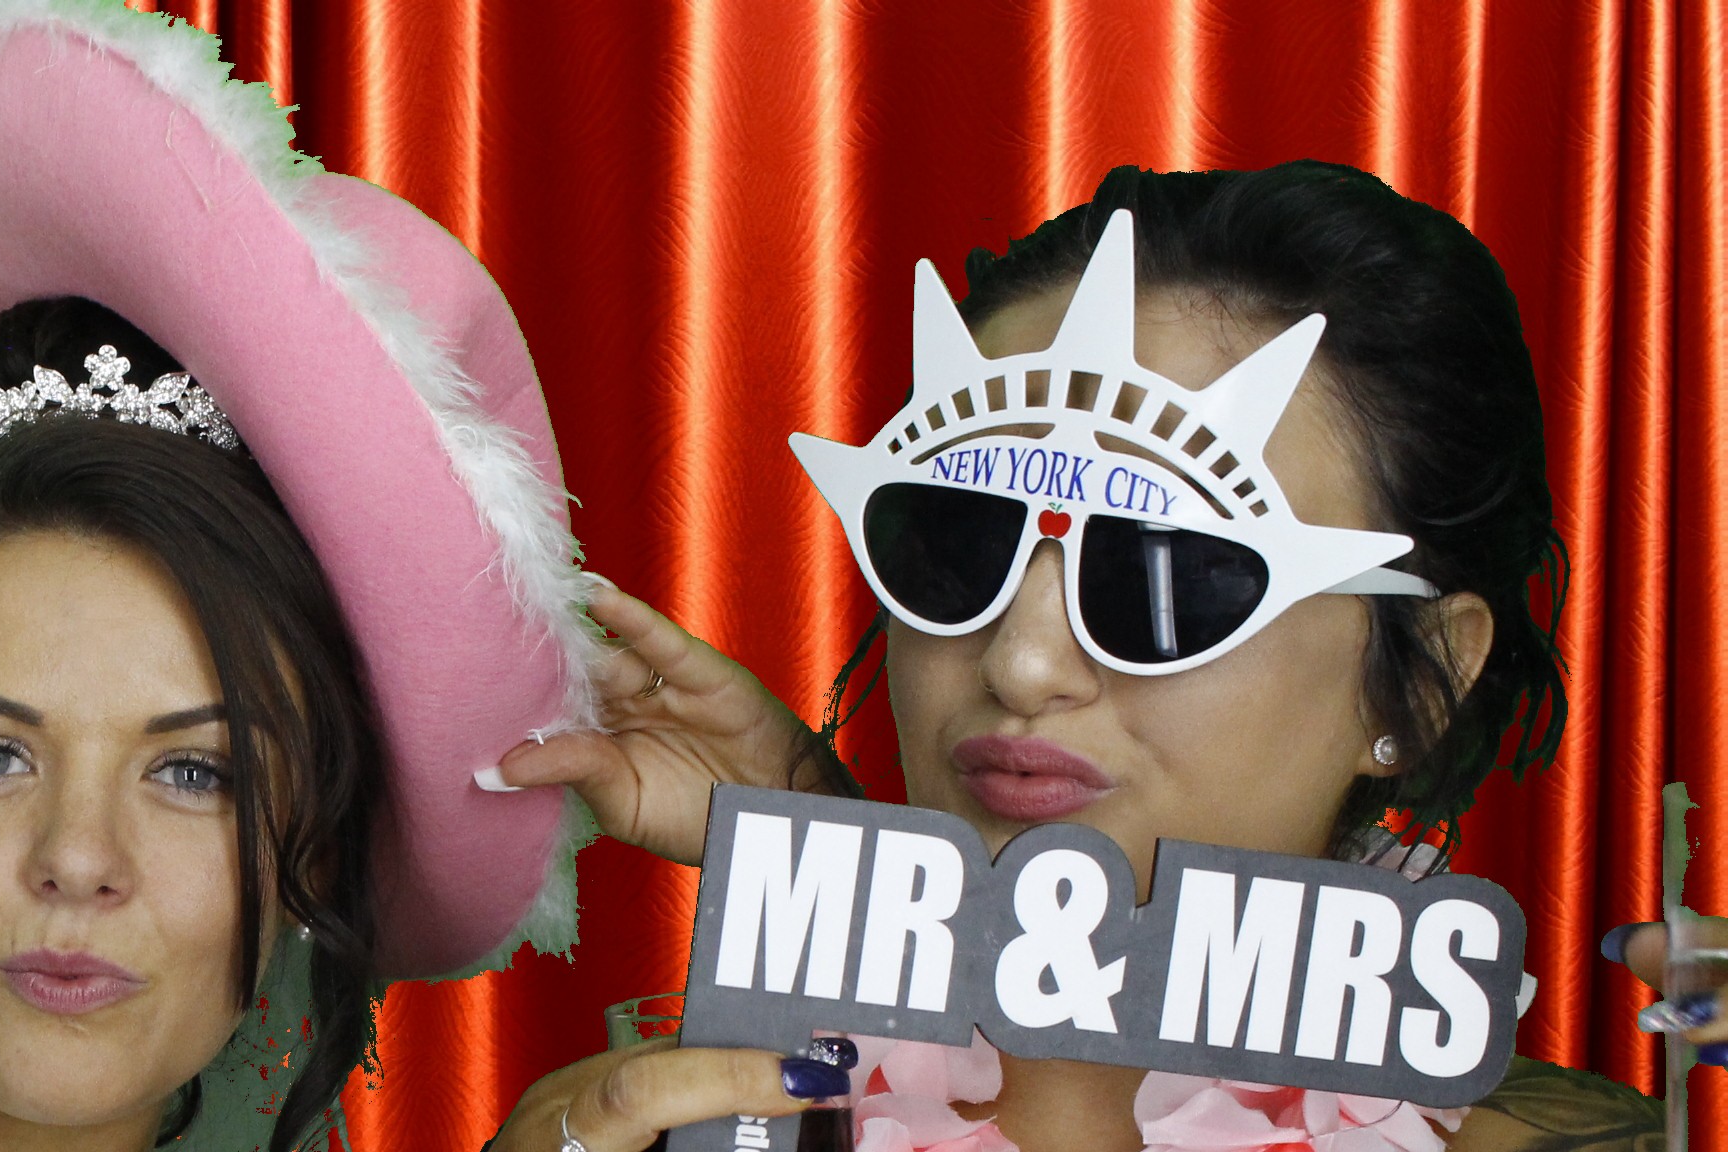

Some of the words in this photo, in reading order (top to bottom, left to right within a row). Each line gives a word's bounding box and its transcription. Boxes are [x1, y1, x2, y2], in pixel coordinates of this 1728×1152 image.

[931, 447, 1000, 488] NEW
[1007, 446, 1095, 503] YORK
[1105, 465, 1178, 516] CITY
[715, 811, 964, 1013] MR
[995, 848, 1127, 1034] &
[1158, 867, 1500, 1078] MRS
